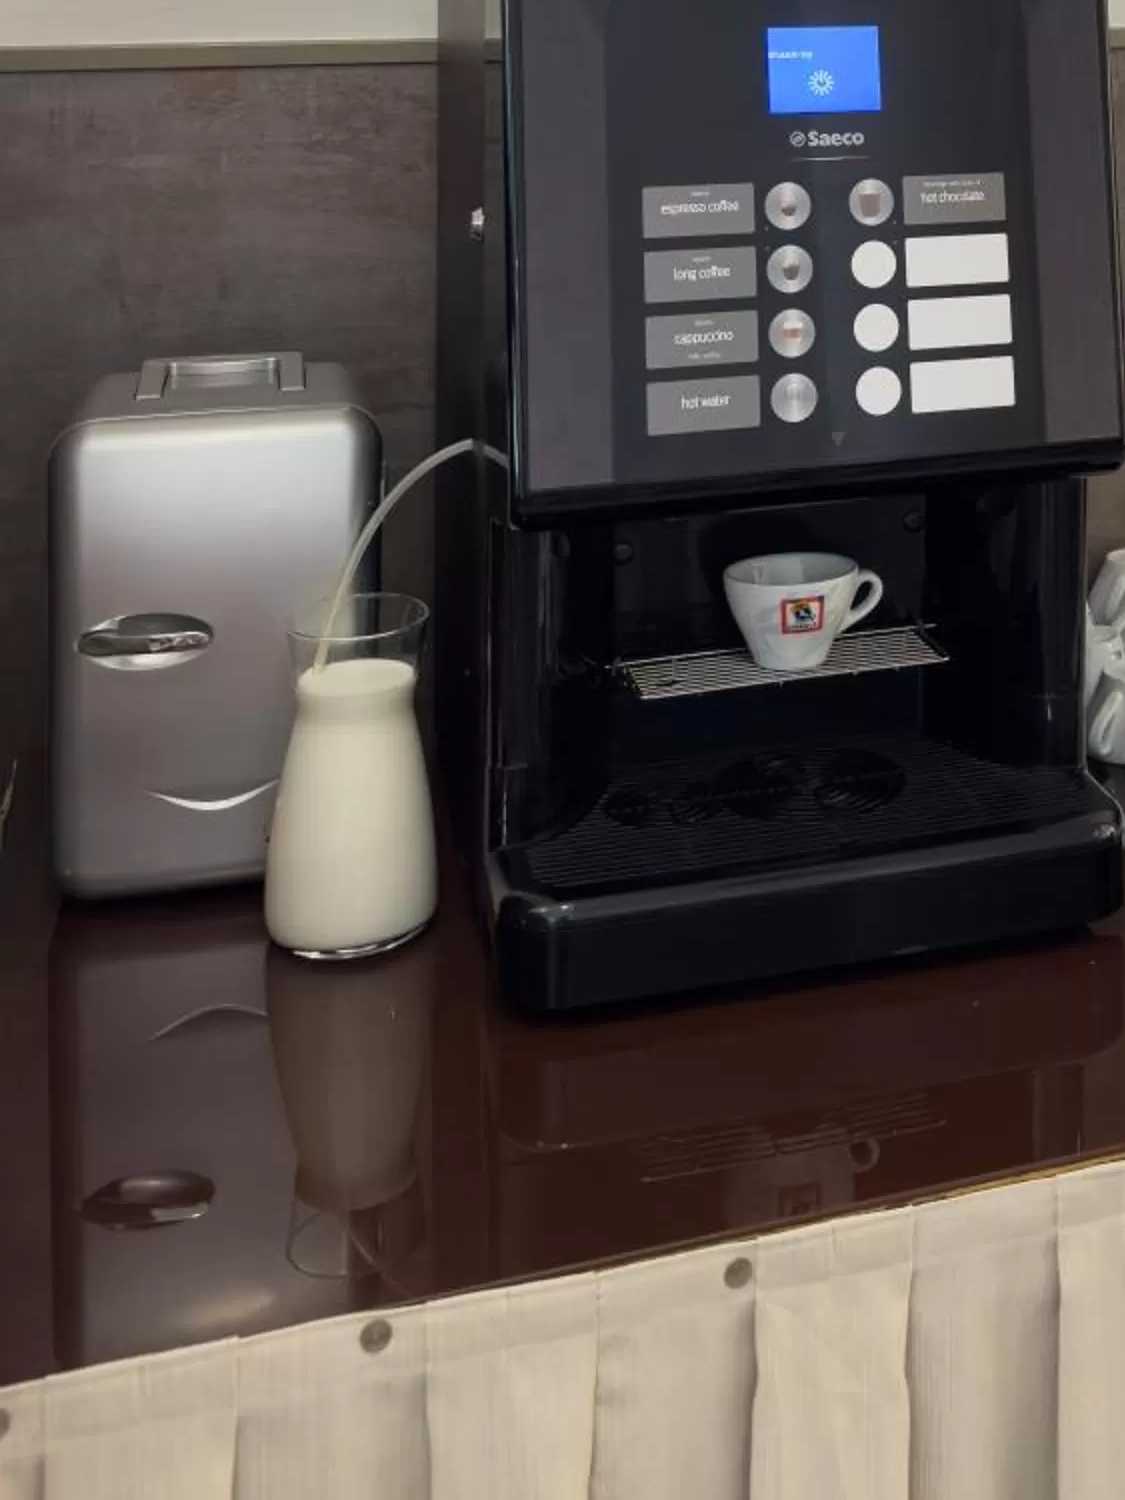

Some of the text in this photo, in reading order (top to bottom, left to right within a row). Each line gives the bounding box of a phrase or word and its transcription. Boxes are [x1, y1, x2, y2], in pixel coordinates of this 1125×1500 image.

[807, 130, 864, 147] Saeco
[708, 199, 739, 213] coffee
[673, 264, 731, 282] long coffee
[673, 330, 734, 346] cappuccino
[681, 394, 731, 410] hot water
